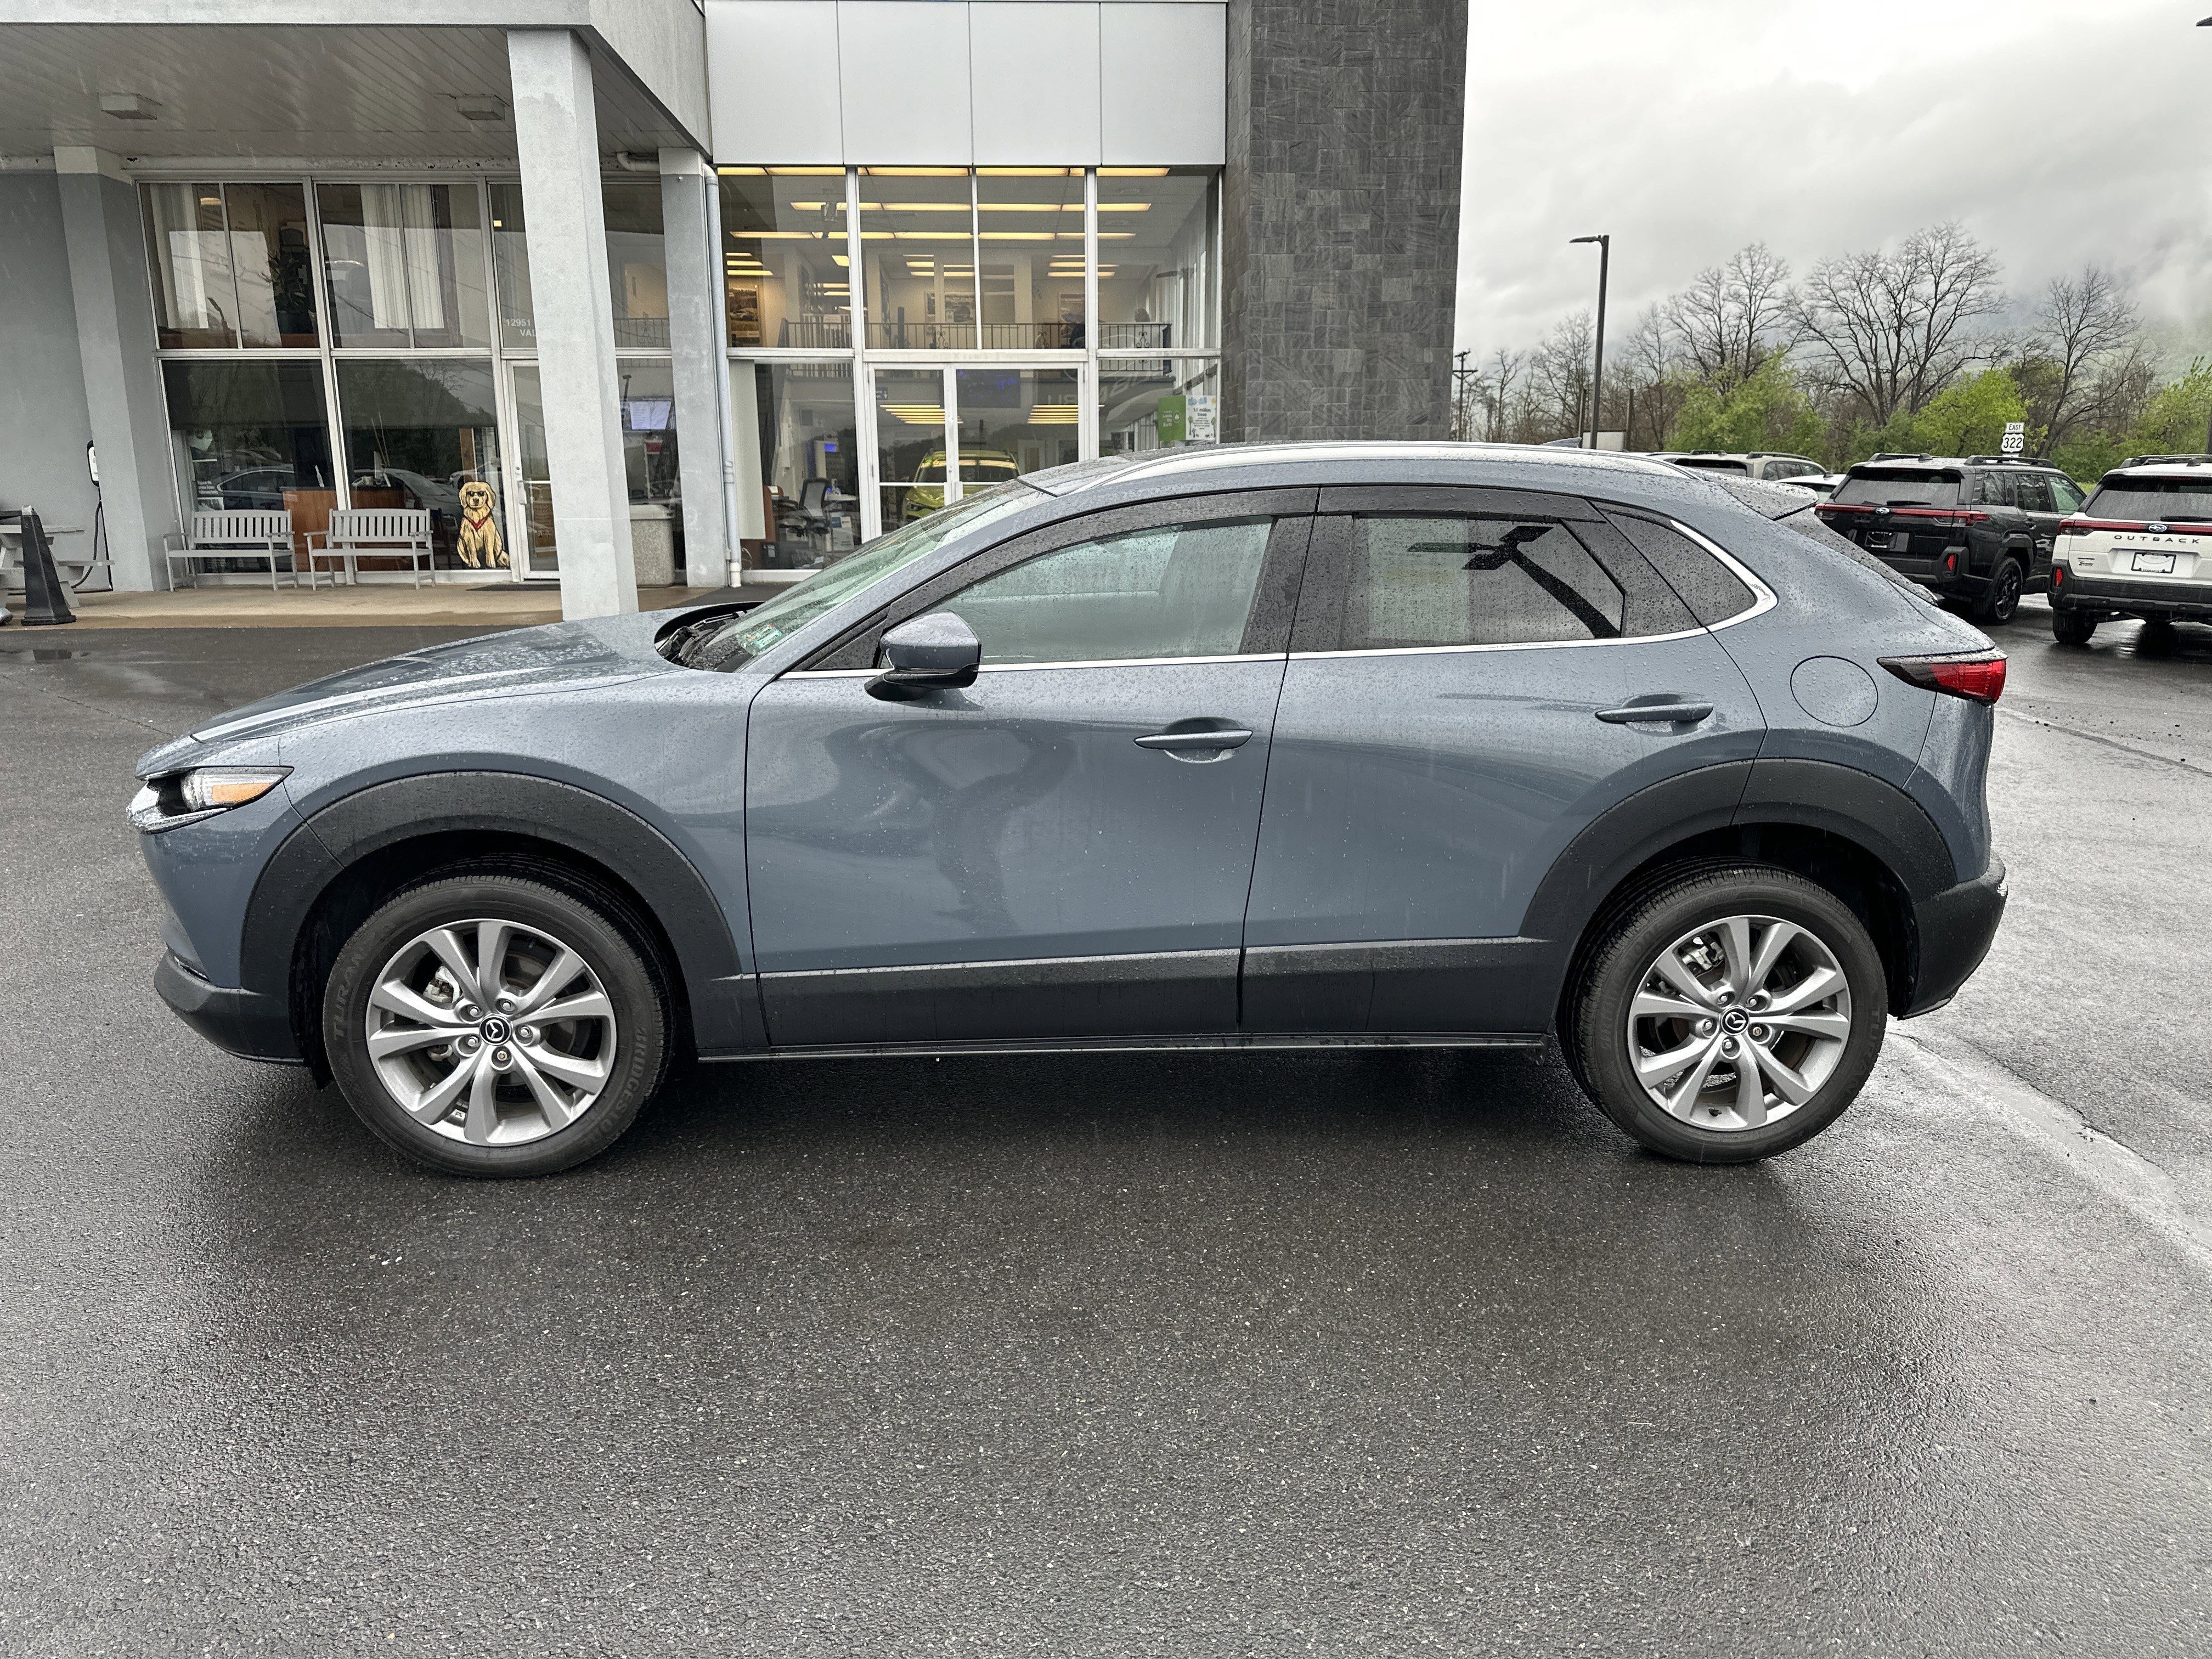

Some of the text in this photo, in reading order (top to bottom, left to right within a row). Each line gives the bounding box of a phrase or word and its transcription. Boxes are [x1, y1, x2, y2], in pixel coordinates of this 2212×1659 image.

[506, 318, 531, 327] 12951
[2003, 437, 2022, 448] 322
[2114, 535, 2200, 544] OUTBACK
[577, 1026, 648, 1149] BRIDGESTONE
